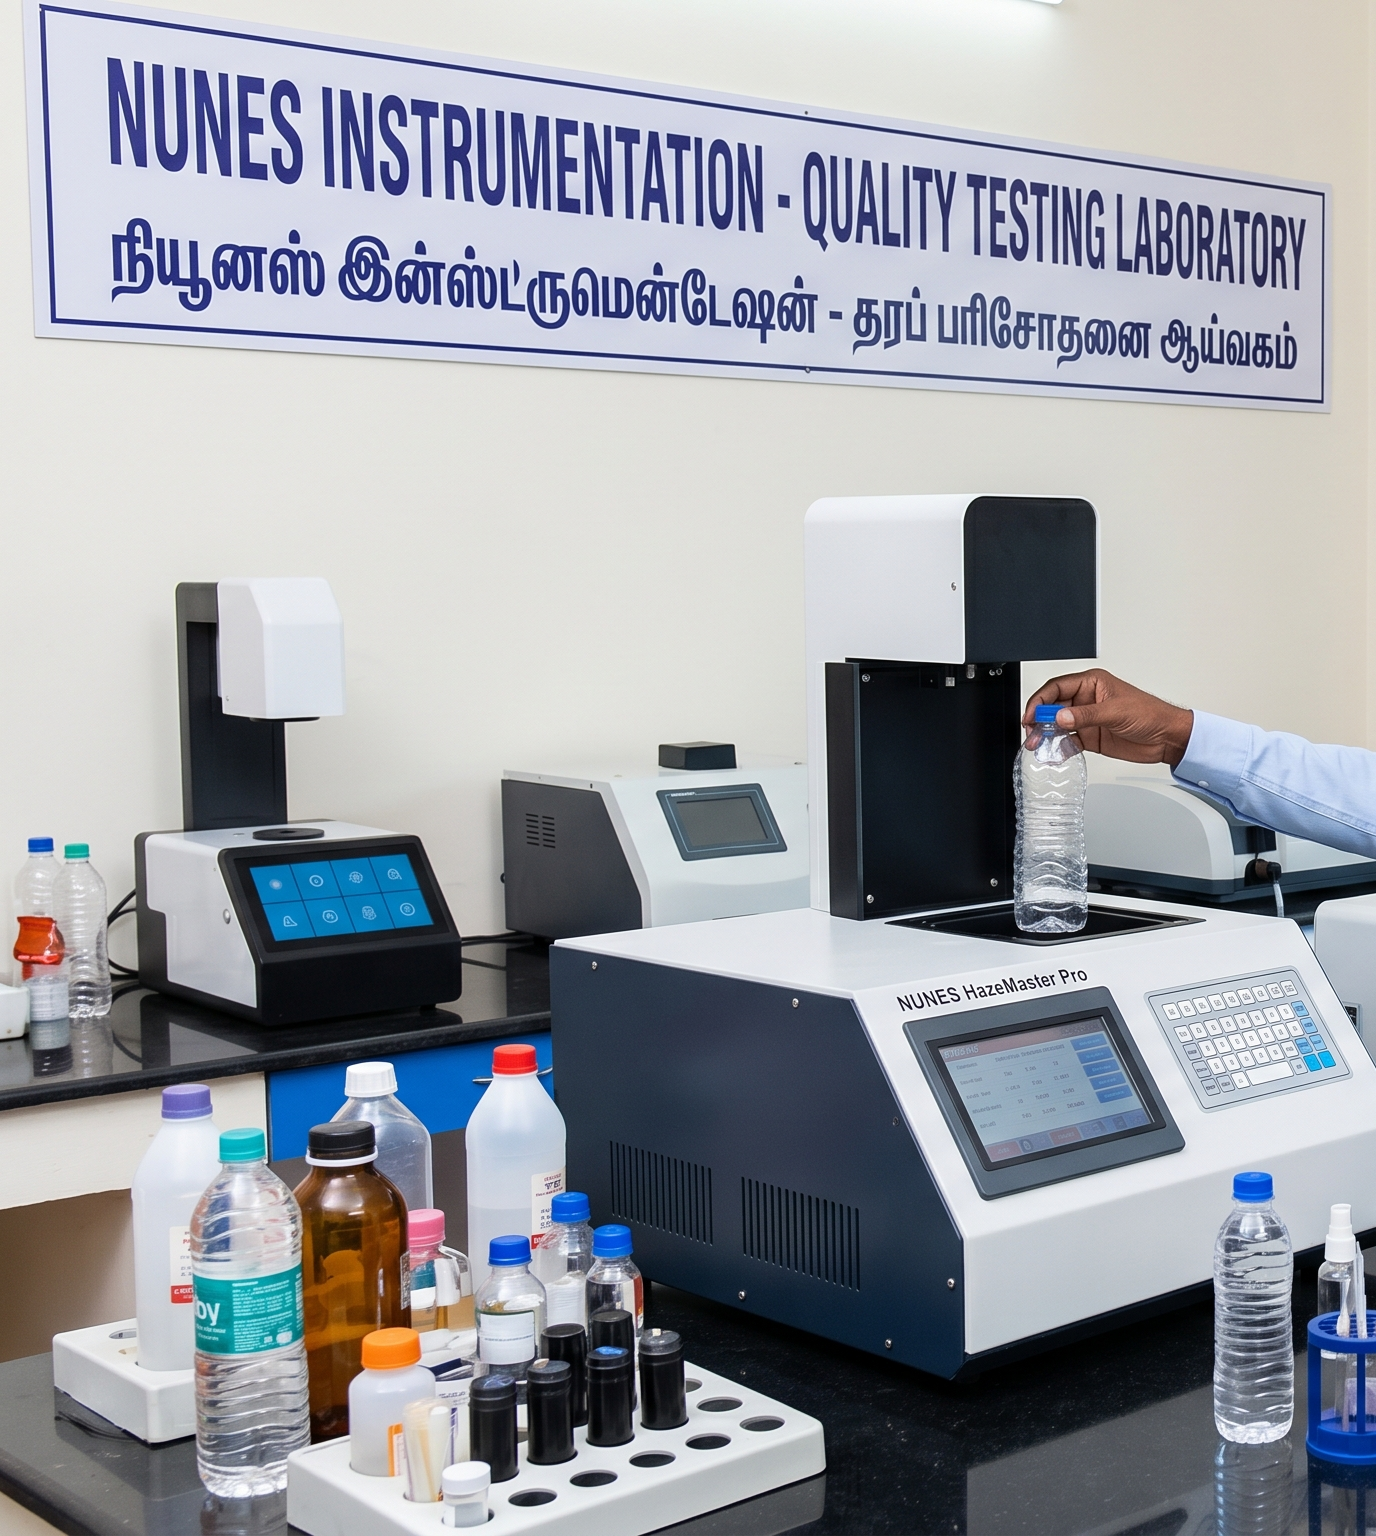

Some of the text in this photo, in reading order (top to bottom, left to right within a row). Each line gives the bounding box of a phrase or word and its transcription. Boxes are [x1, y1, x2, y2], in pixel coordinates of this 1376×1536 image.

[107, 57, 1307, 291] NUNES INSTRUMENTATION - QUALITY TESTING LABORATORY
[111, 218, 326, 312] நியூனஸ்
[853, 287, 927, 355] தரப்
[937, 293, 1152, 369] பரிசோதனை
[1161, 313, 1298, 374] ஆய்வகம்
[896, 968, 1088, 1012] NUNES HazeMaster Pro
